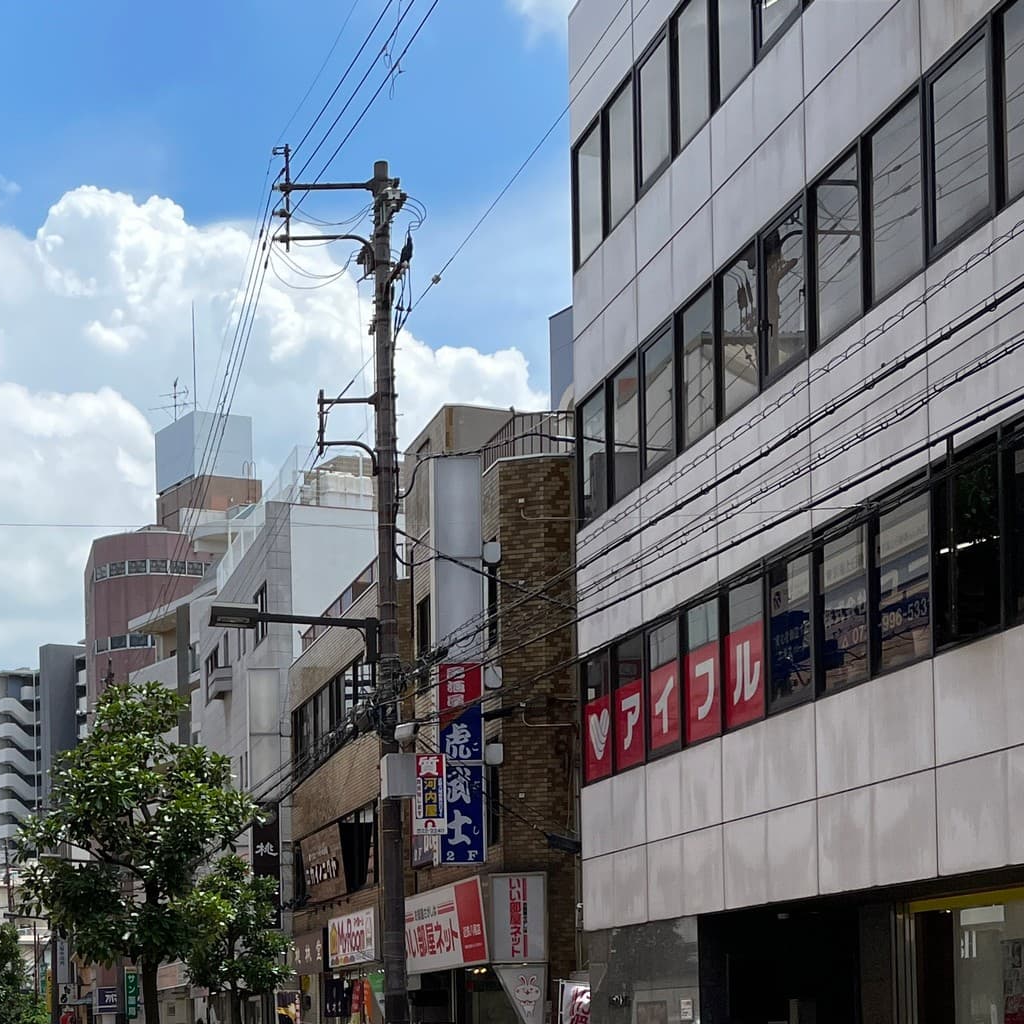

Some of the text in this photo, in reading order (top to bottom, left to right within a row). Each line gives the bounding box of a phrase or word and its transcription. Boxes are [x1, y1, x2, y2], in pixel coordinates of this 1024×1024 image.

[621, 639, 761, 751] アイフル
[419, 756, 440, 776] 質
[423, 777, 439, 818] 河内屋
[509, 878, 522, 958] いい部屋ネット
